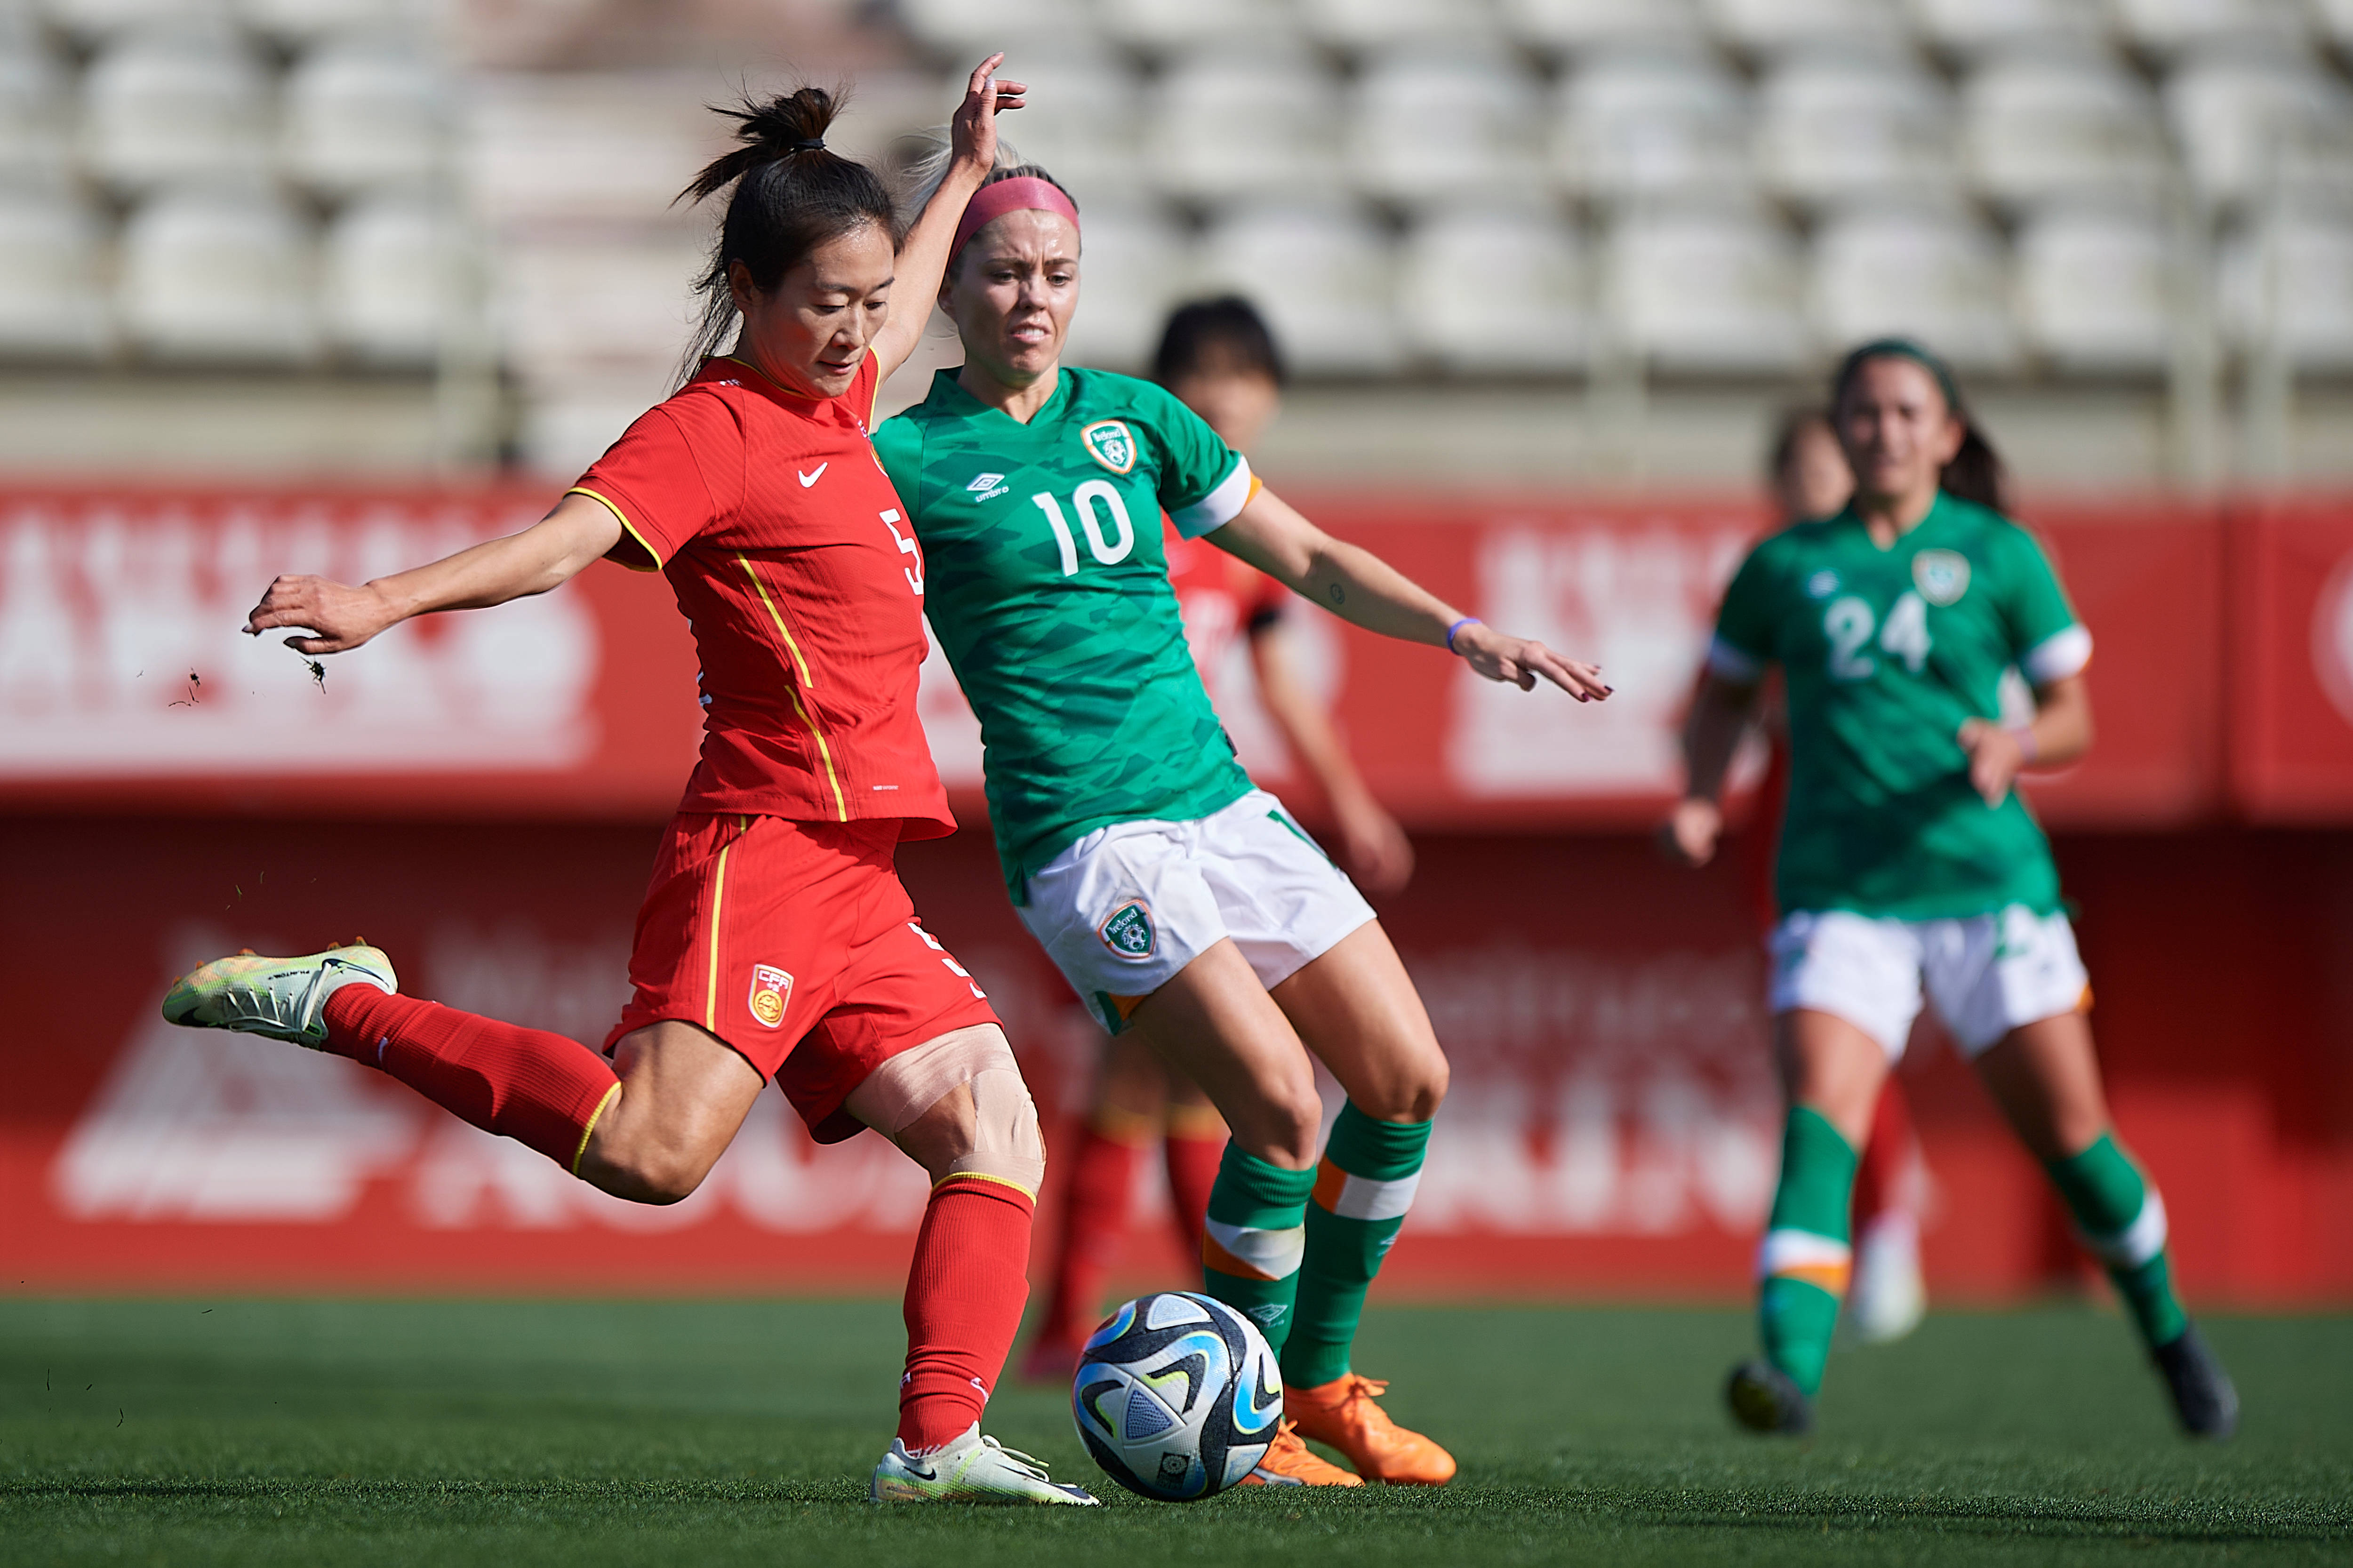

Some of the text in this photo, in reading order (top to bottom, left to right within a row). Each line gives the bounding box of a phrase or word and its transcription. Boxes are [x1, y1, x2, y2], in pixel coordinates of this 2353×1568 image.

[975, 485, 1009, 503] umbro
[879, 508, 924, 595] 5
[1032, 479, 1134, 577] 10
[1824, 589, 1933, 679] 24
[1107, 908, 1138, 934] Ireland
[758, 969, 790, 990] CFA
